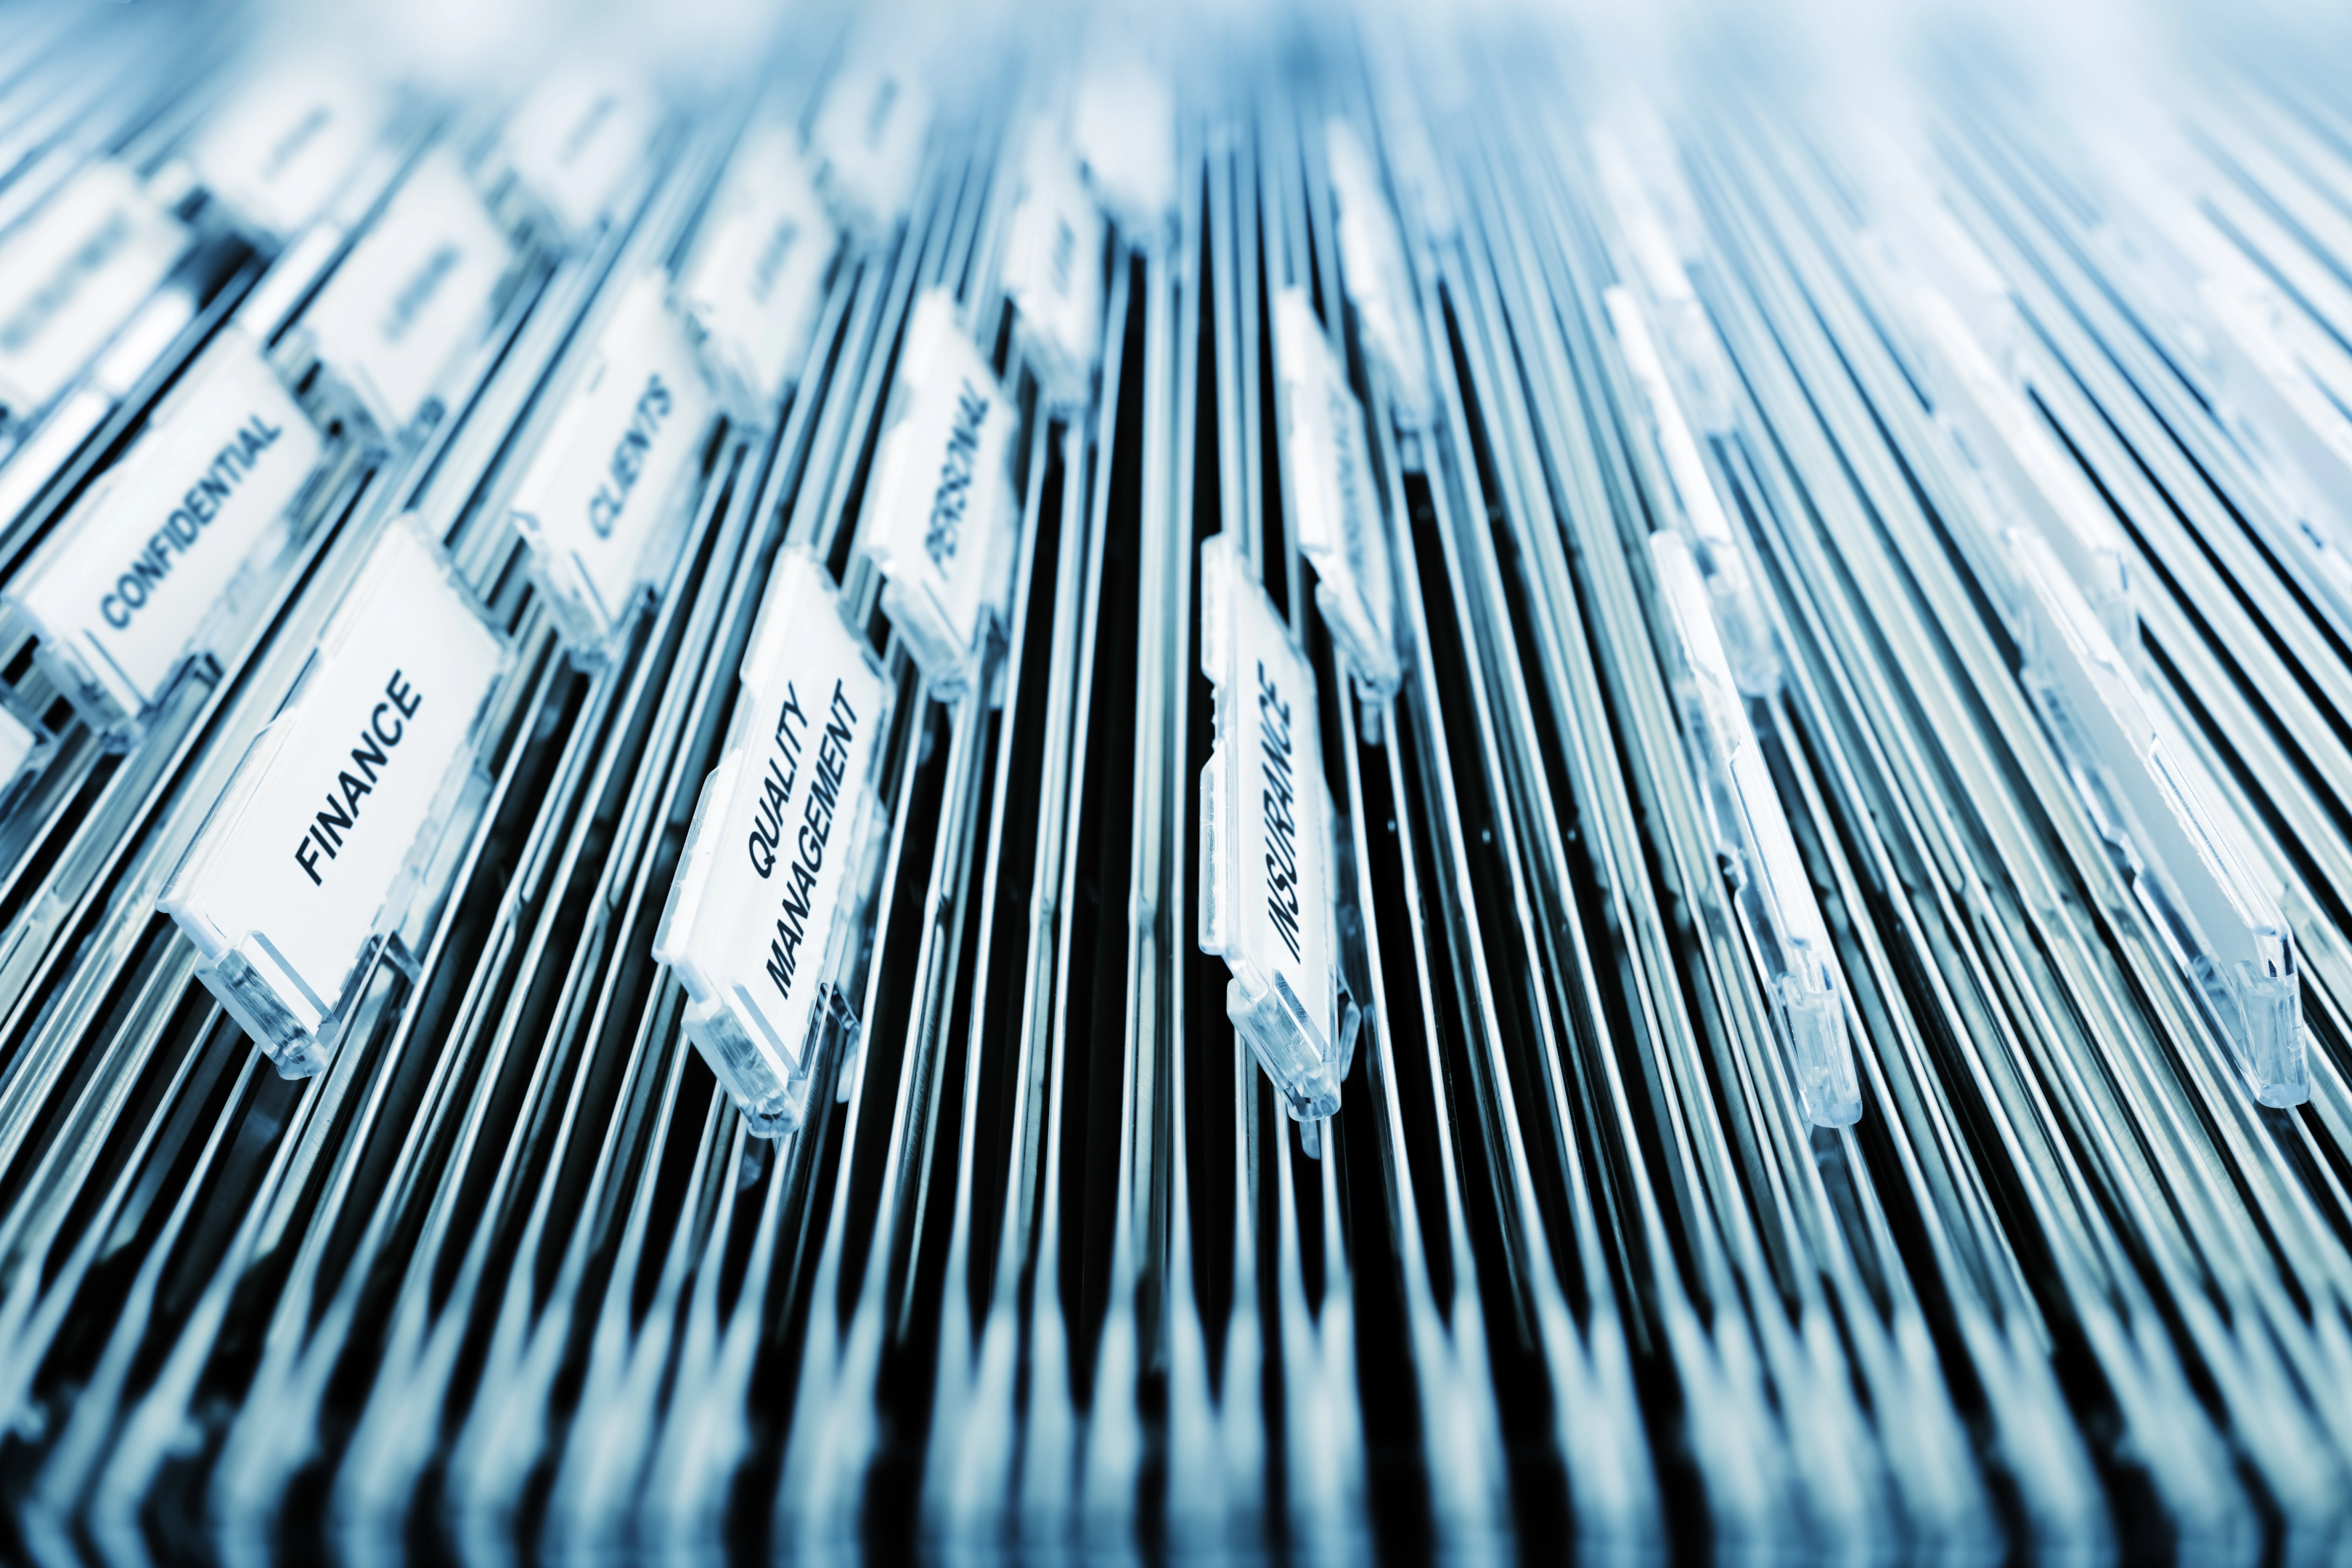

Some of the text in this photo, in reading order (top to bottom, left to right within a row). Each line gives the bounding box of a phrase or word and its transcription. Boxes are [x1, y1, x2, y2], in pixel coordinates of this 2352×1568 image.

[101, 413, 282, 629] CONFIDENTIAL
[589, 374, 671, 539] CLIENTS
[925, 377, 988, 581] PERSONAL
[295, 670, 422, 886] FINANCE
[748, 680, 807, 879] QUALITY
[766, 678, 857, 1000] MANAGEMENT
[1258, 659, 1300, 965] INSURANCE
